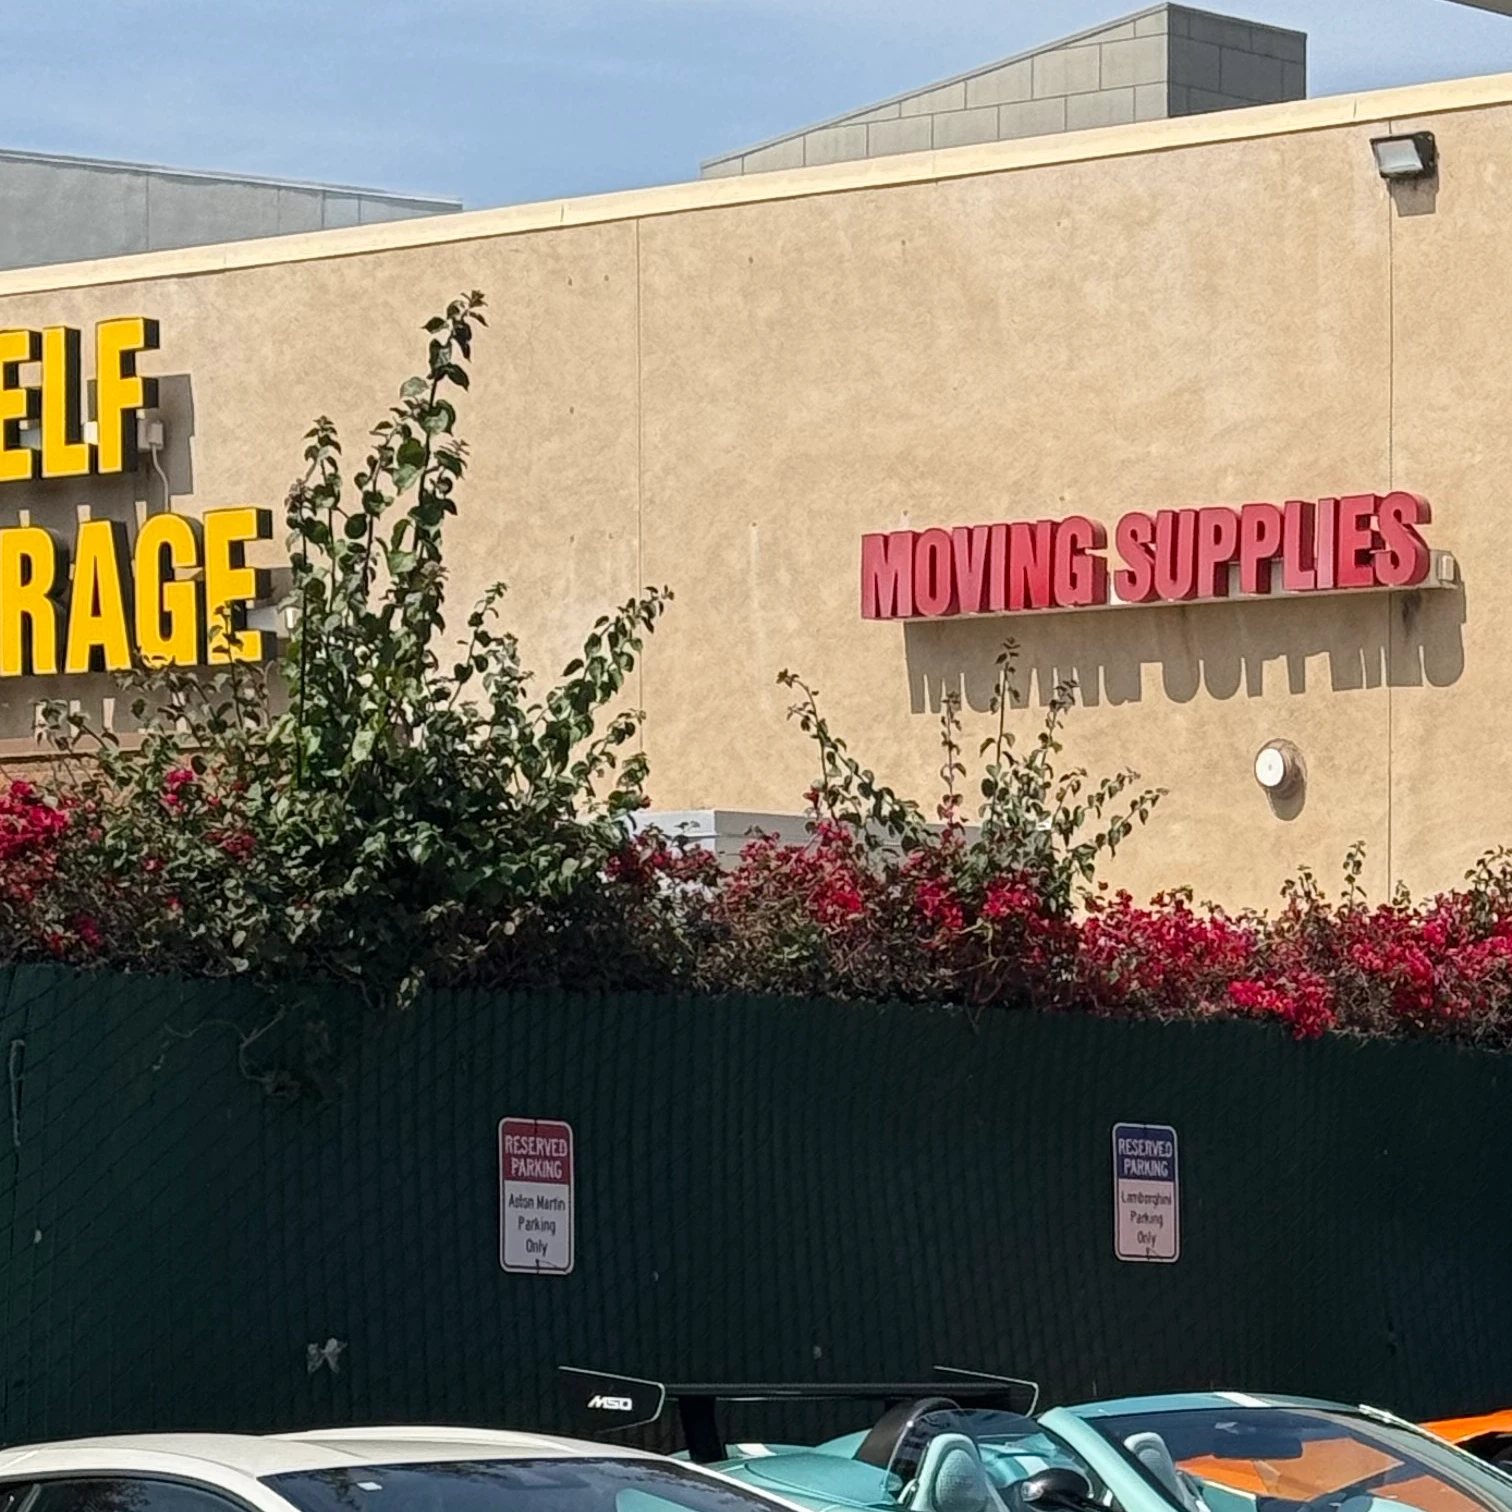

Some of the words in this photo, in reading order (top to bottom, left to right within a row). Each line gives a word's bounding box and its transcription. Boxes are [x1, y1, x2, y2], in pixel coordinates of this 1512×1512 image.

[862, 516, 1106, 620] MOVING
[1114, 491, 1431, 603] SUPPLIES
[0, 507, 274, 676] RAGE
[504, 1135, 568, 1157] RESERVED
[1118, 1138, 1173, 1158] RESERVED
[511, 1157, 563, 1179] PARKING
[1123, 1158, 1169, 1177] PARKING
[508, 1193, 534, 1209] Aston
[537, 1195, 566, 1211] Martin
[1121, 1190, 1172, 1209] Lamborghini
[518, 1216, 556, 1236] Parking
[1130, 1210, 1163, 1229] Parking
[525, 1238, 548, 1257] Only
[1137, 1231, 1157, 1248] Only
[588, 1395, 633, 1411] MSO
